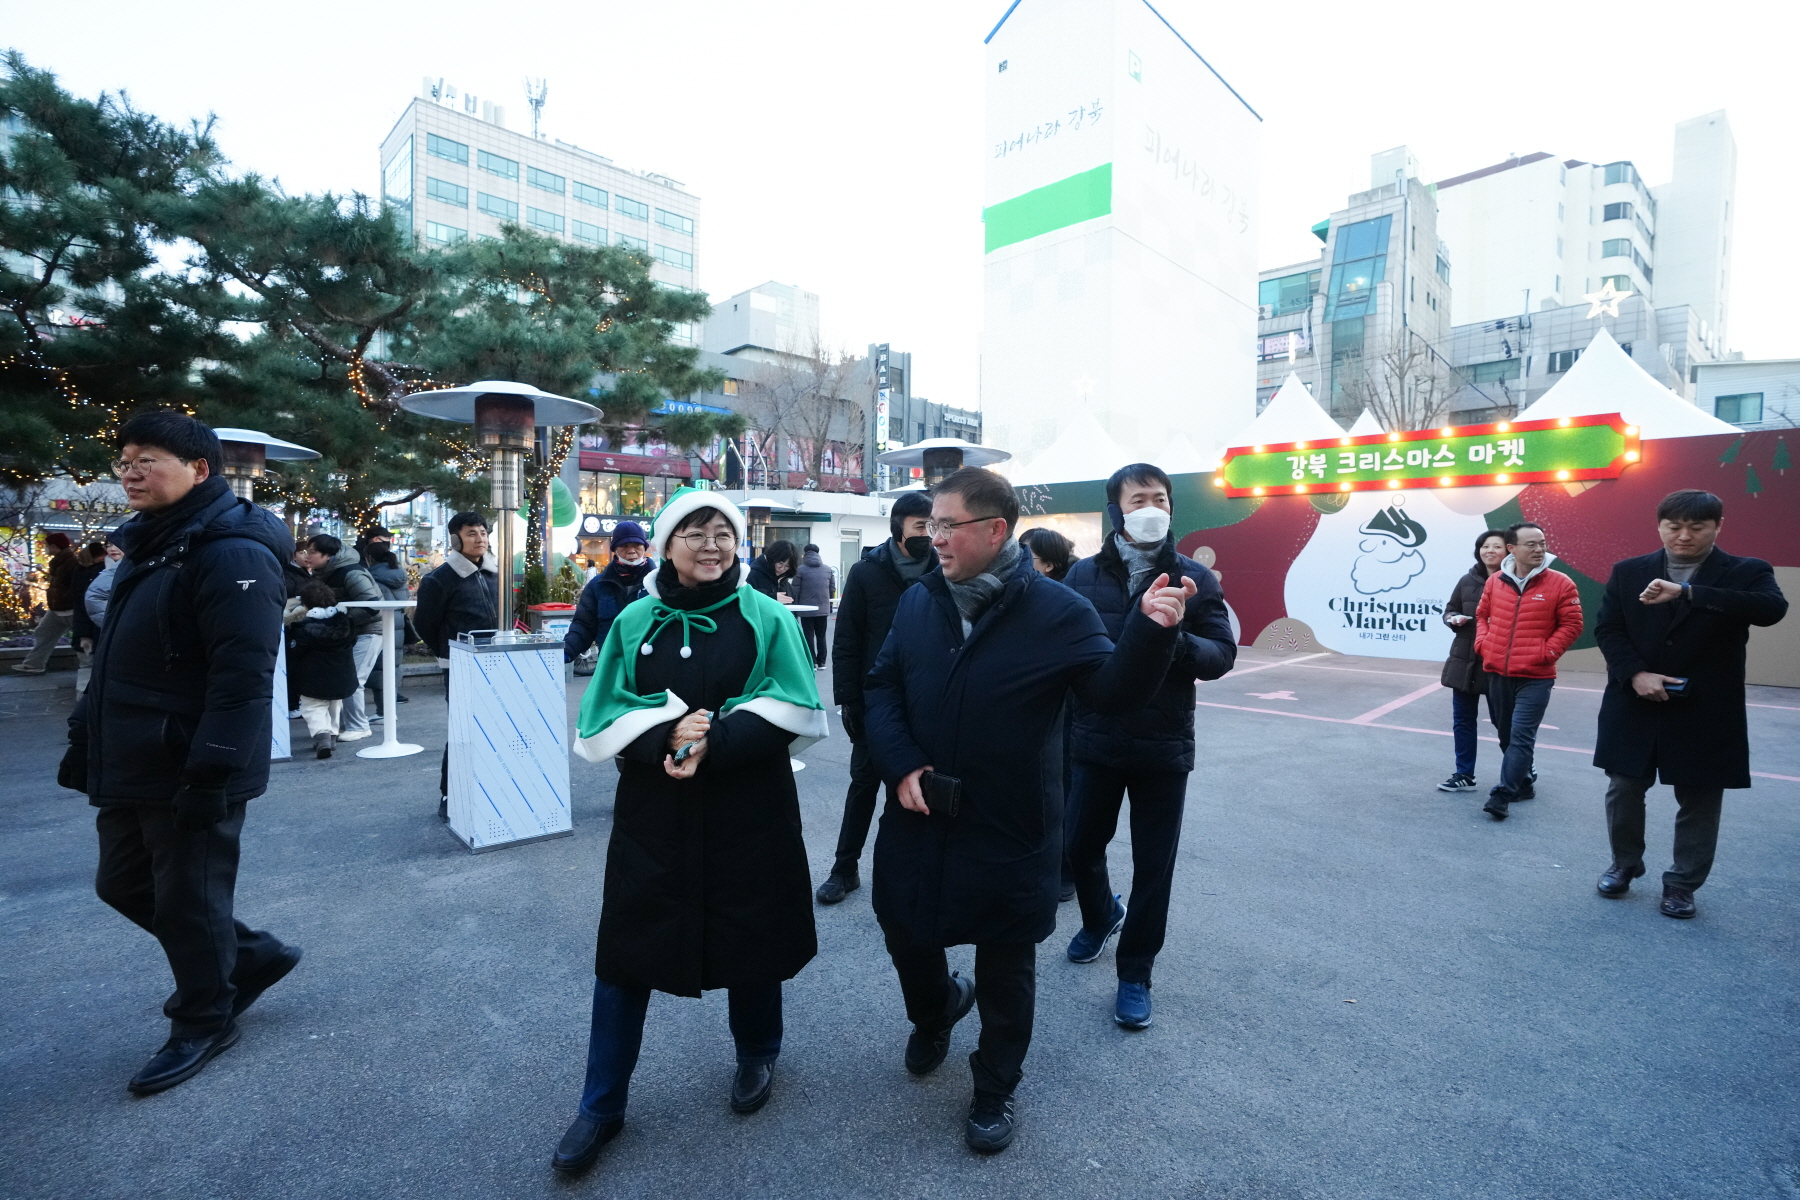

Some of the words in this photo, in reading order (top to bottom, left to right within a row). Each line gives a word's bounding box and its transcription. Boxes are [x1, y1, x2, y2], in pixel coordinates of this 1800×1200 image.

[994, 119, 1061, 159] 피어나라
[1068, 97, 1104, 131] 강북
[1286, 453, 1328, 480] 강북
[1336, 444, 1456, 474] 크리스마스
[1468, 438, 1525, 467] 마켓
[1328, 597, 1444, 615] Christmas
[1342, 613, 1428, 632] Market
[1359, 632, 1374, 640] 내가
[1375, 632, 1390, 641] 그린
[1391, 634, 1407, 642] 산타
